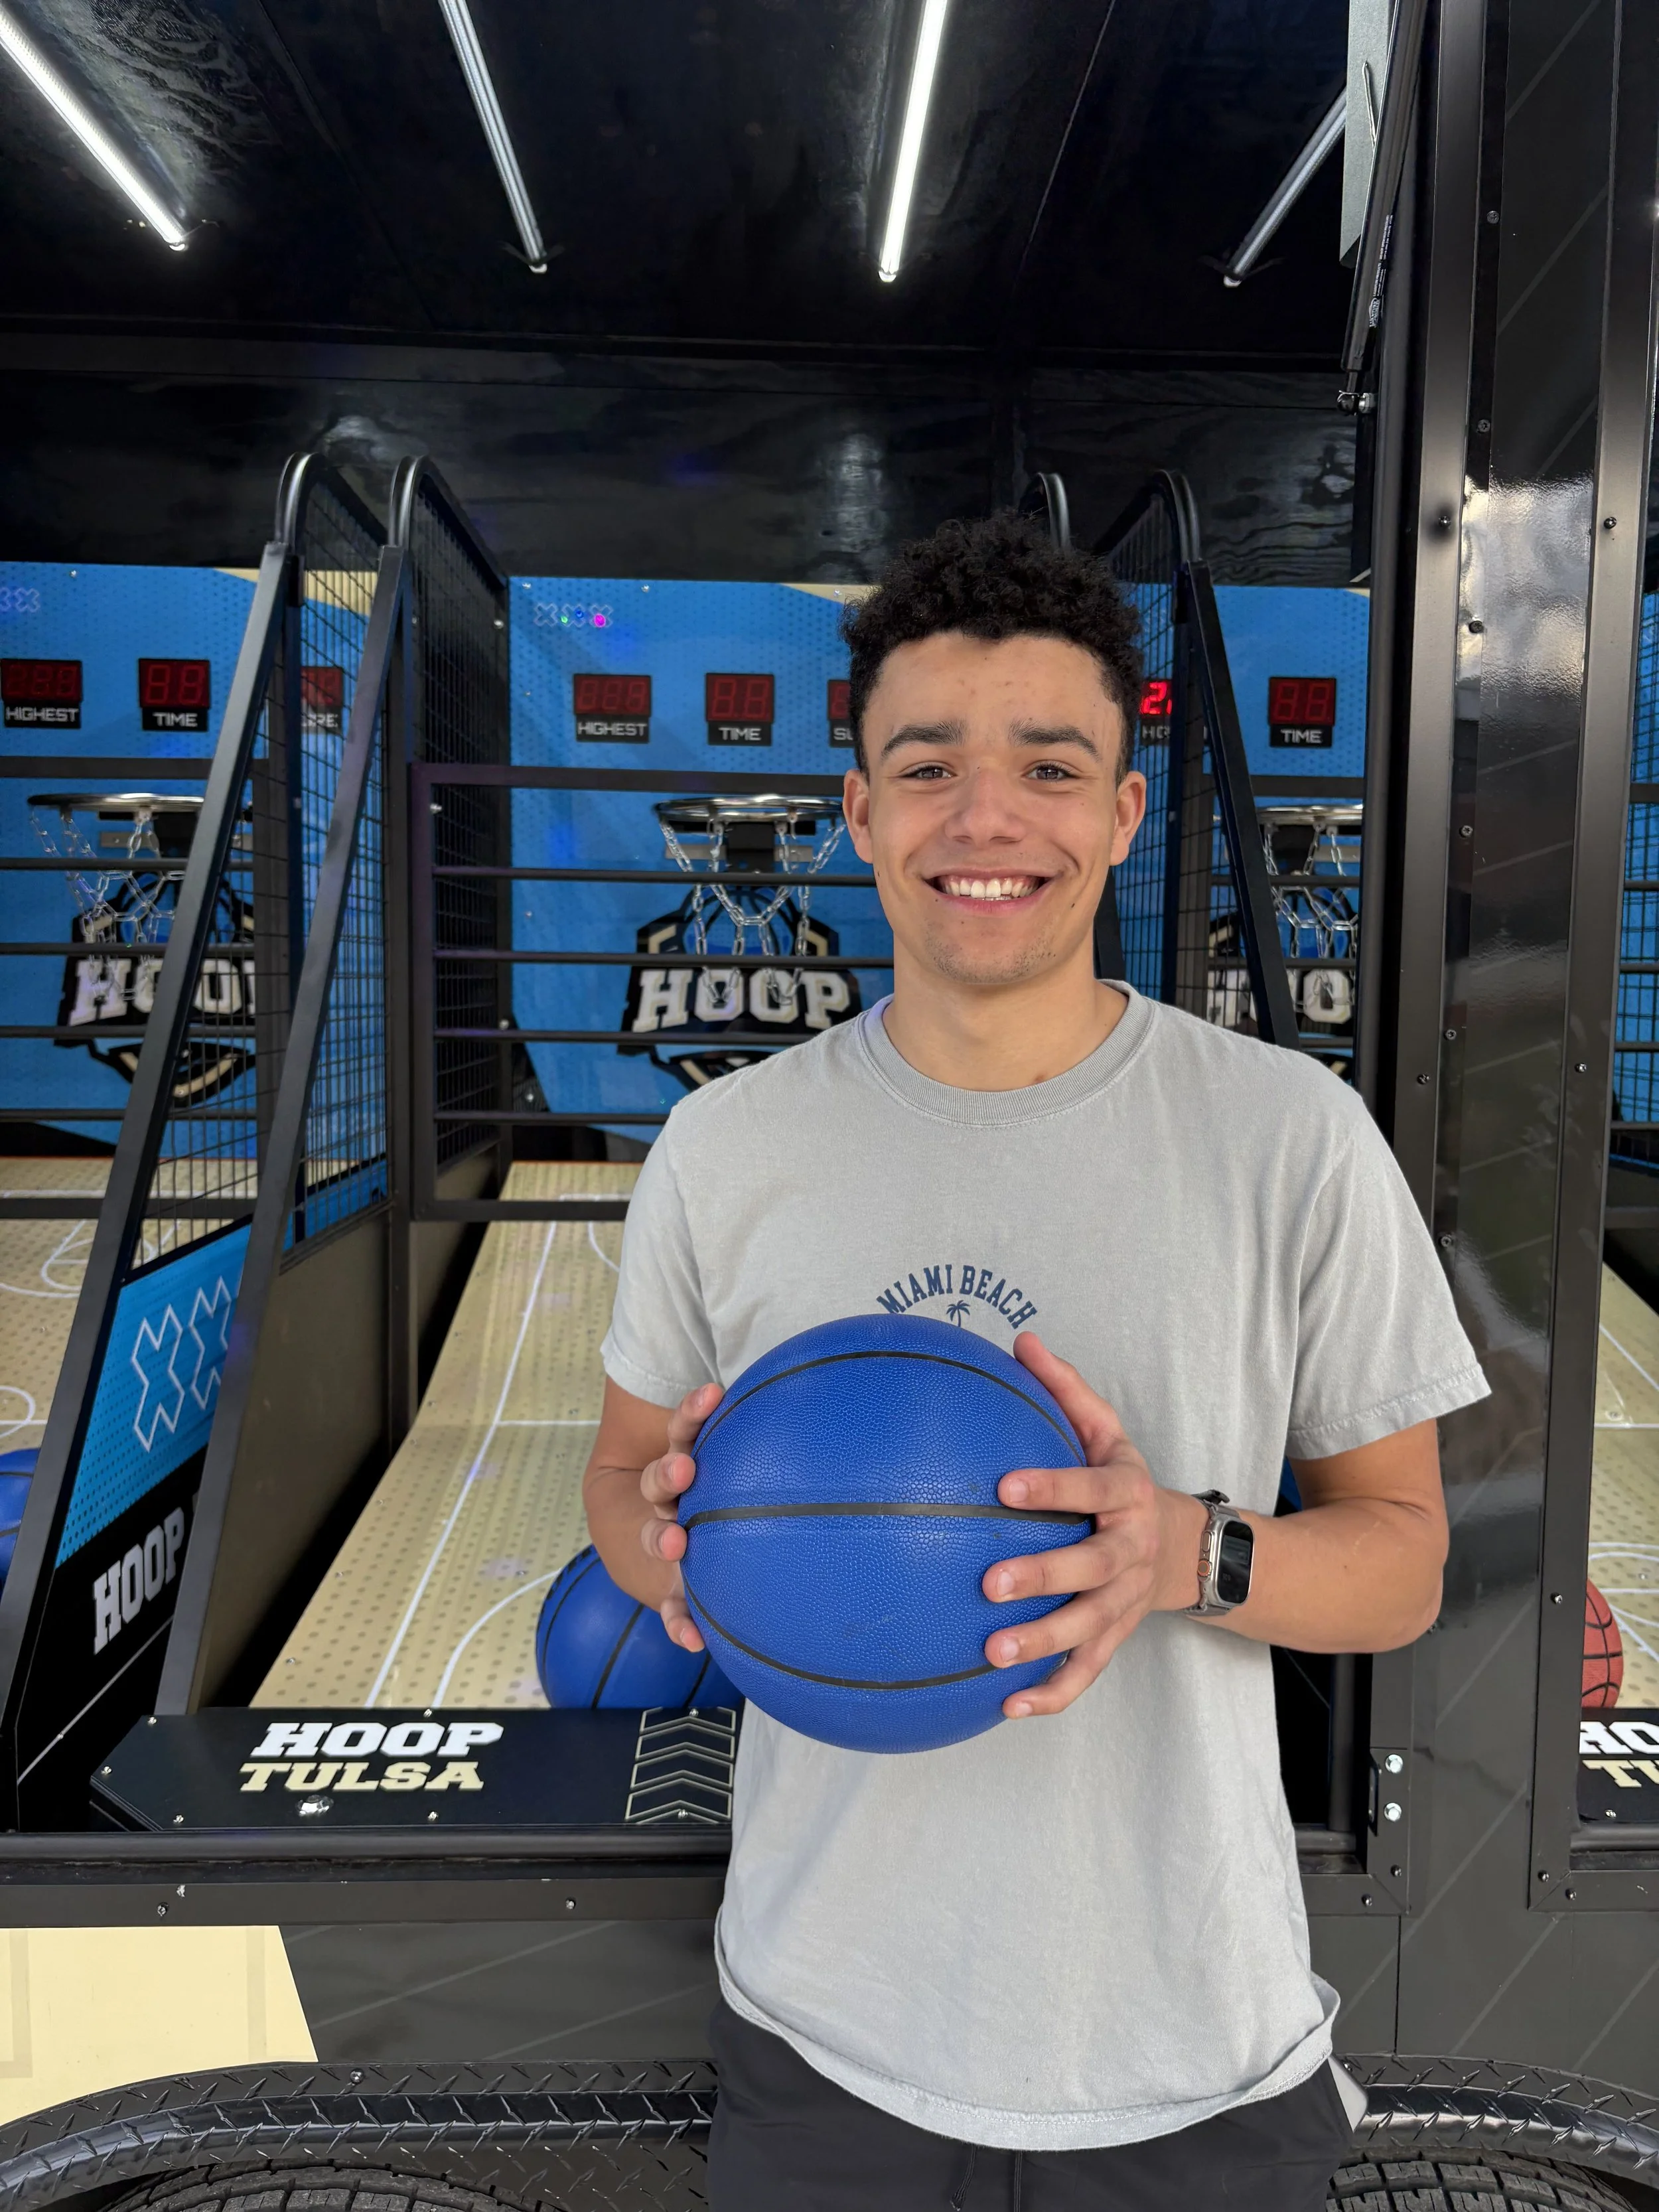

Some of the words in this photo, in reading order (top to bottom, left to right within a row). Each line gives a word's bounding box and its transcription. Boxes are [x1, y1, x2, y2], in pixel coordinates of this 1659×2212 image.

[5, 707, 78, 722] HIGHEST
[152, 711, 198, 727] TIME
[577, 721, 648, 737] HIGHEST
[718, 727, 761, 741] TIME
[1281, 728, 1323, 743] TIME
[632, 968, 851, 1033] HOOP
[876, 1264, 954, 1314] MIAMI
[960, 1265, 1038, 1330] BEACH
[93, 1506, 185, 1656] HOOP
[250, 1722, 504, 1757] HOOP
[239, 1761, 484, 1792] TULSA
